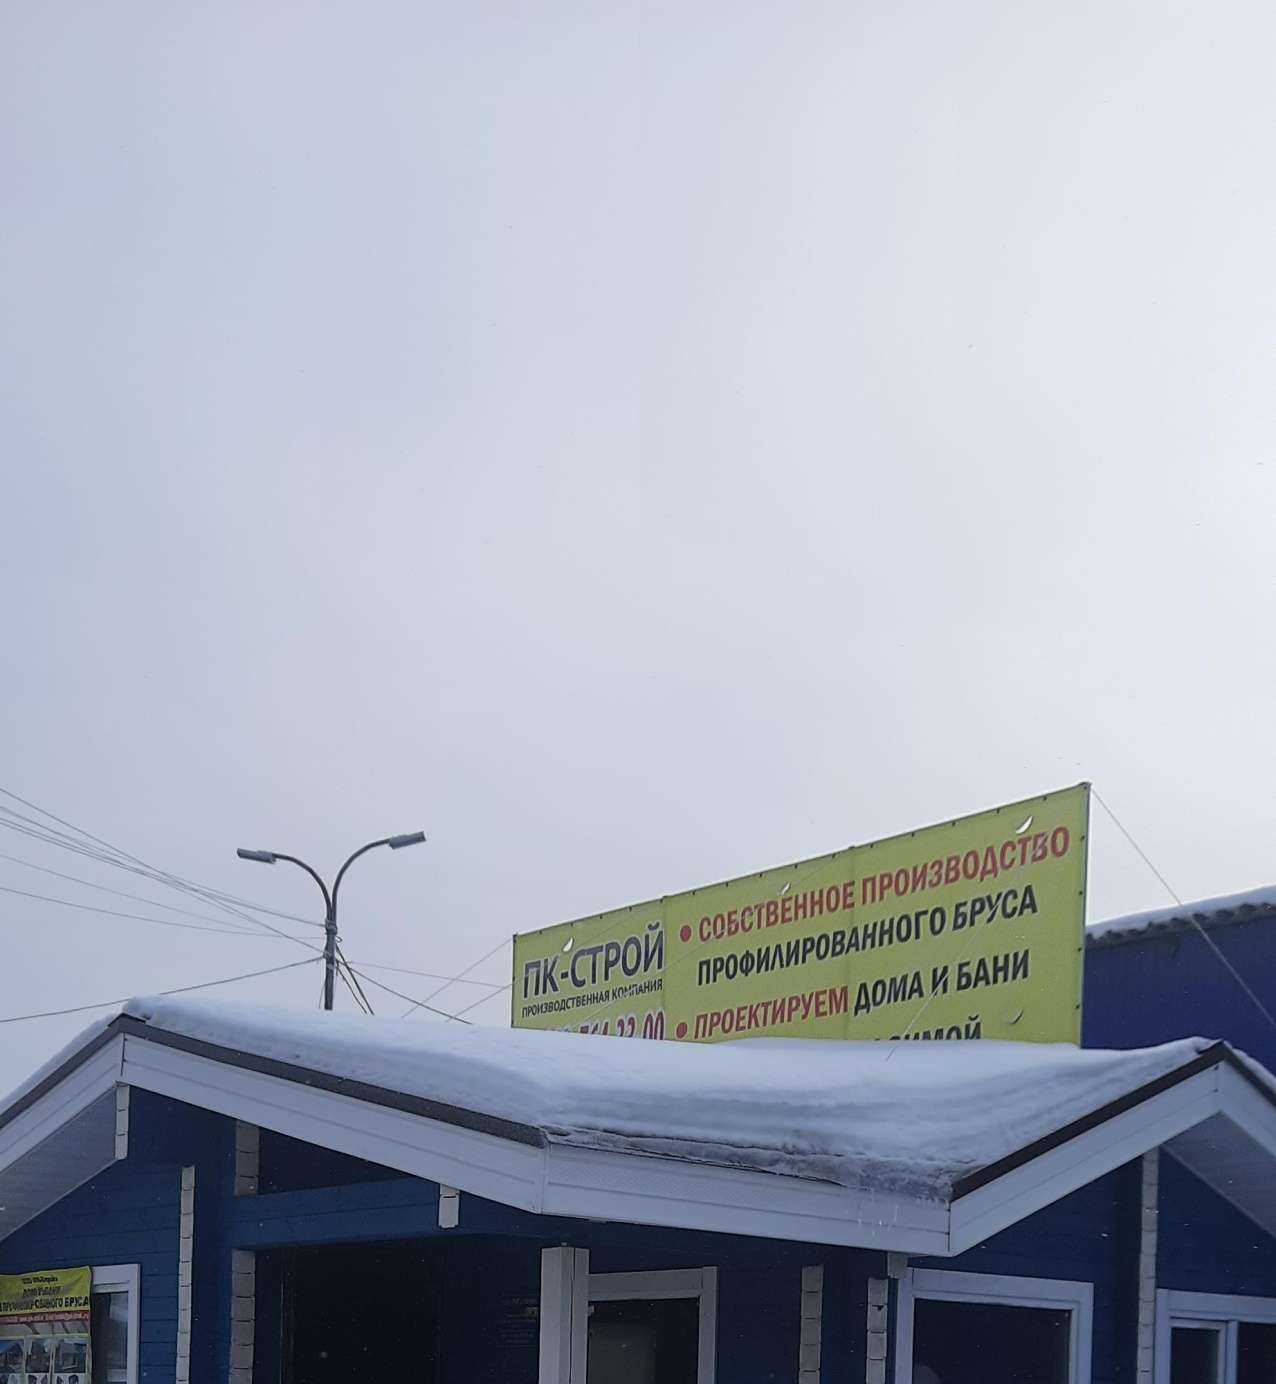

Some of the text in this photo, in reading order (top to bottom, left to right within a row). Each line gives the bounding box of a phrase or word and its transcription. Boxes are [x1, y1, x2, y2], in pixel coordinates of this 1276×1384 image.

[698, 826, 1071, 943] СОБСТВЕННОЕ ПРОИЗВОДСТВО
[522, 921, 665, 999] ПК-СТРОЙ
[697, 884, 1039, 986] ПРОФИЛИРОВАННОГО БРУСА
[521, 978, 663, 1019] ПРОИЗВОДСТВЕННАЯ КОМПАНИЯ
[693, 949, 1030, 1040] ПРОЕКТИРУЕМ ДОМА И БАНИ
